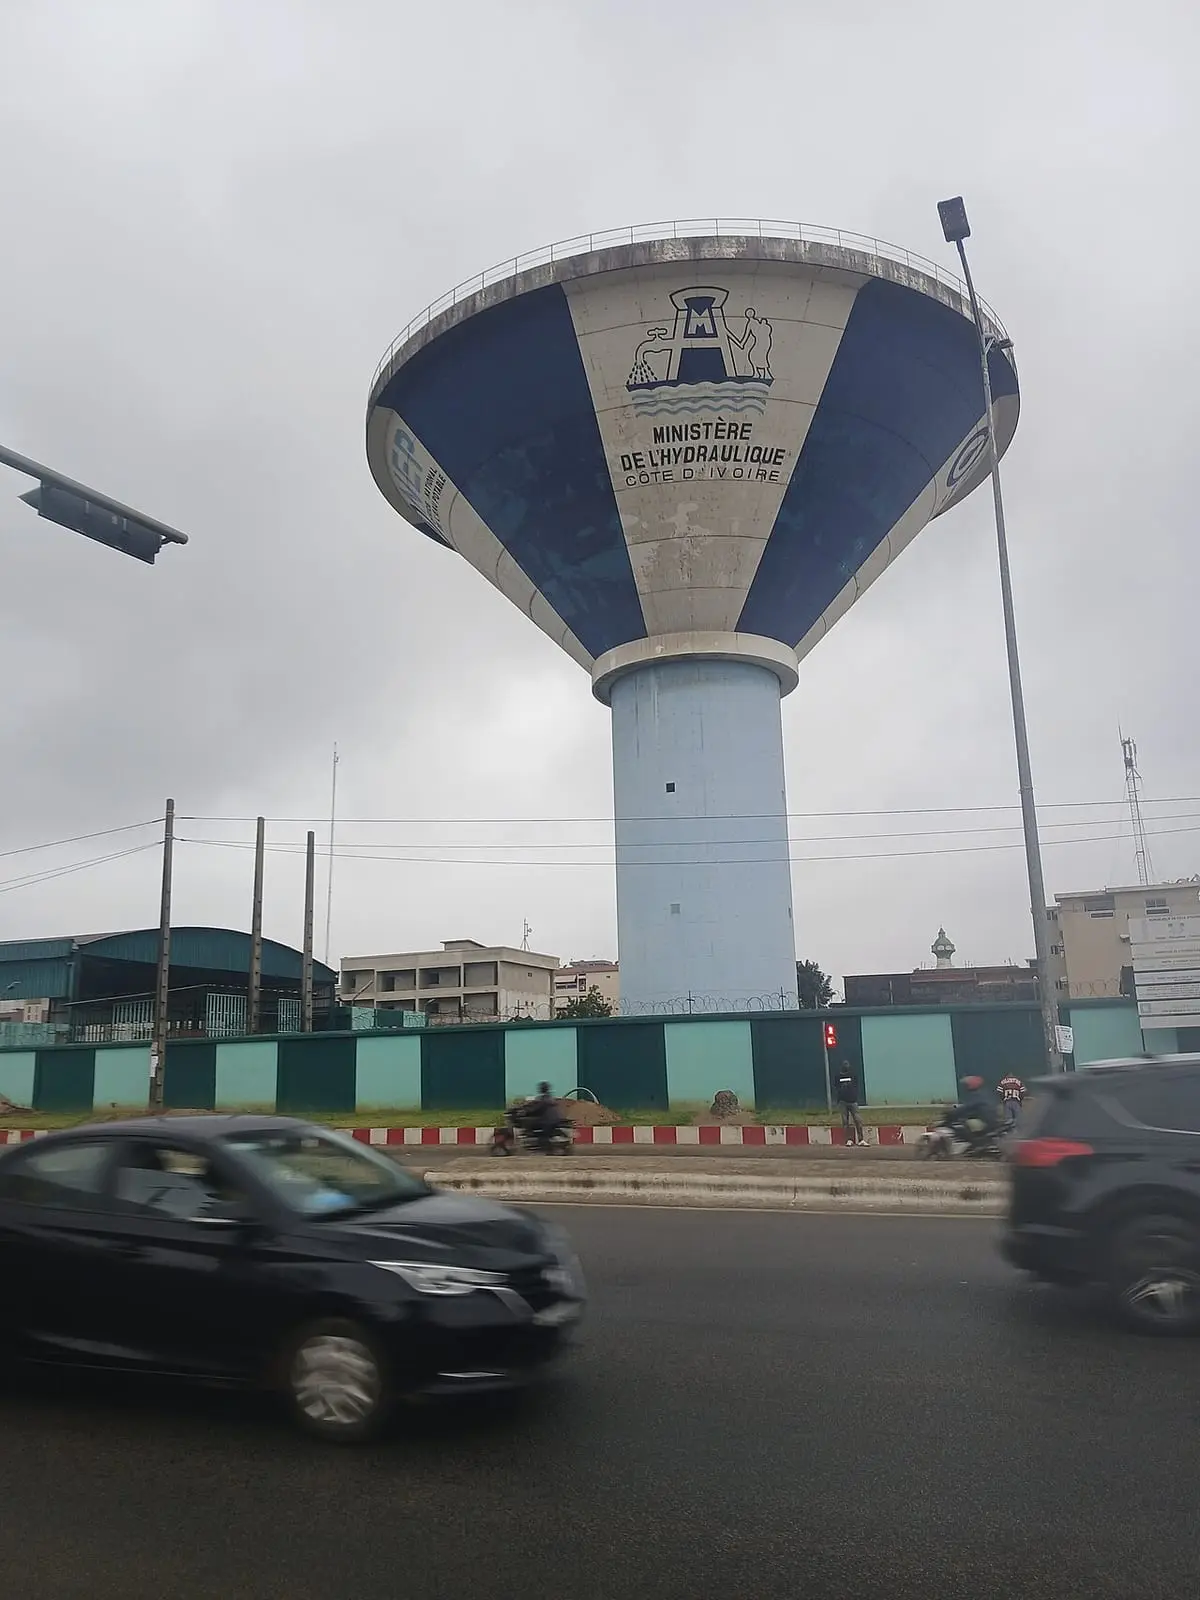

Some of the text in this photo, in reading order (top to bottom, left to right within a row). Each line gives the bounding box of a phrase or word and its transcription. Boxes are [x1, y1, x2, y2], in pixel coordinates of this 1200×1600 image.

[653, 416, 752, 444] MINISTÈRE
[621, 444, 786, 471] DE L'HYDRAULIQUE
[625, 469, 674, 487] CÔTE
